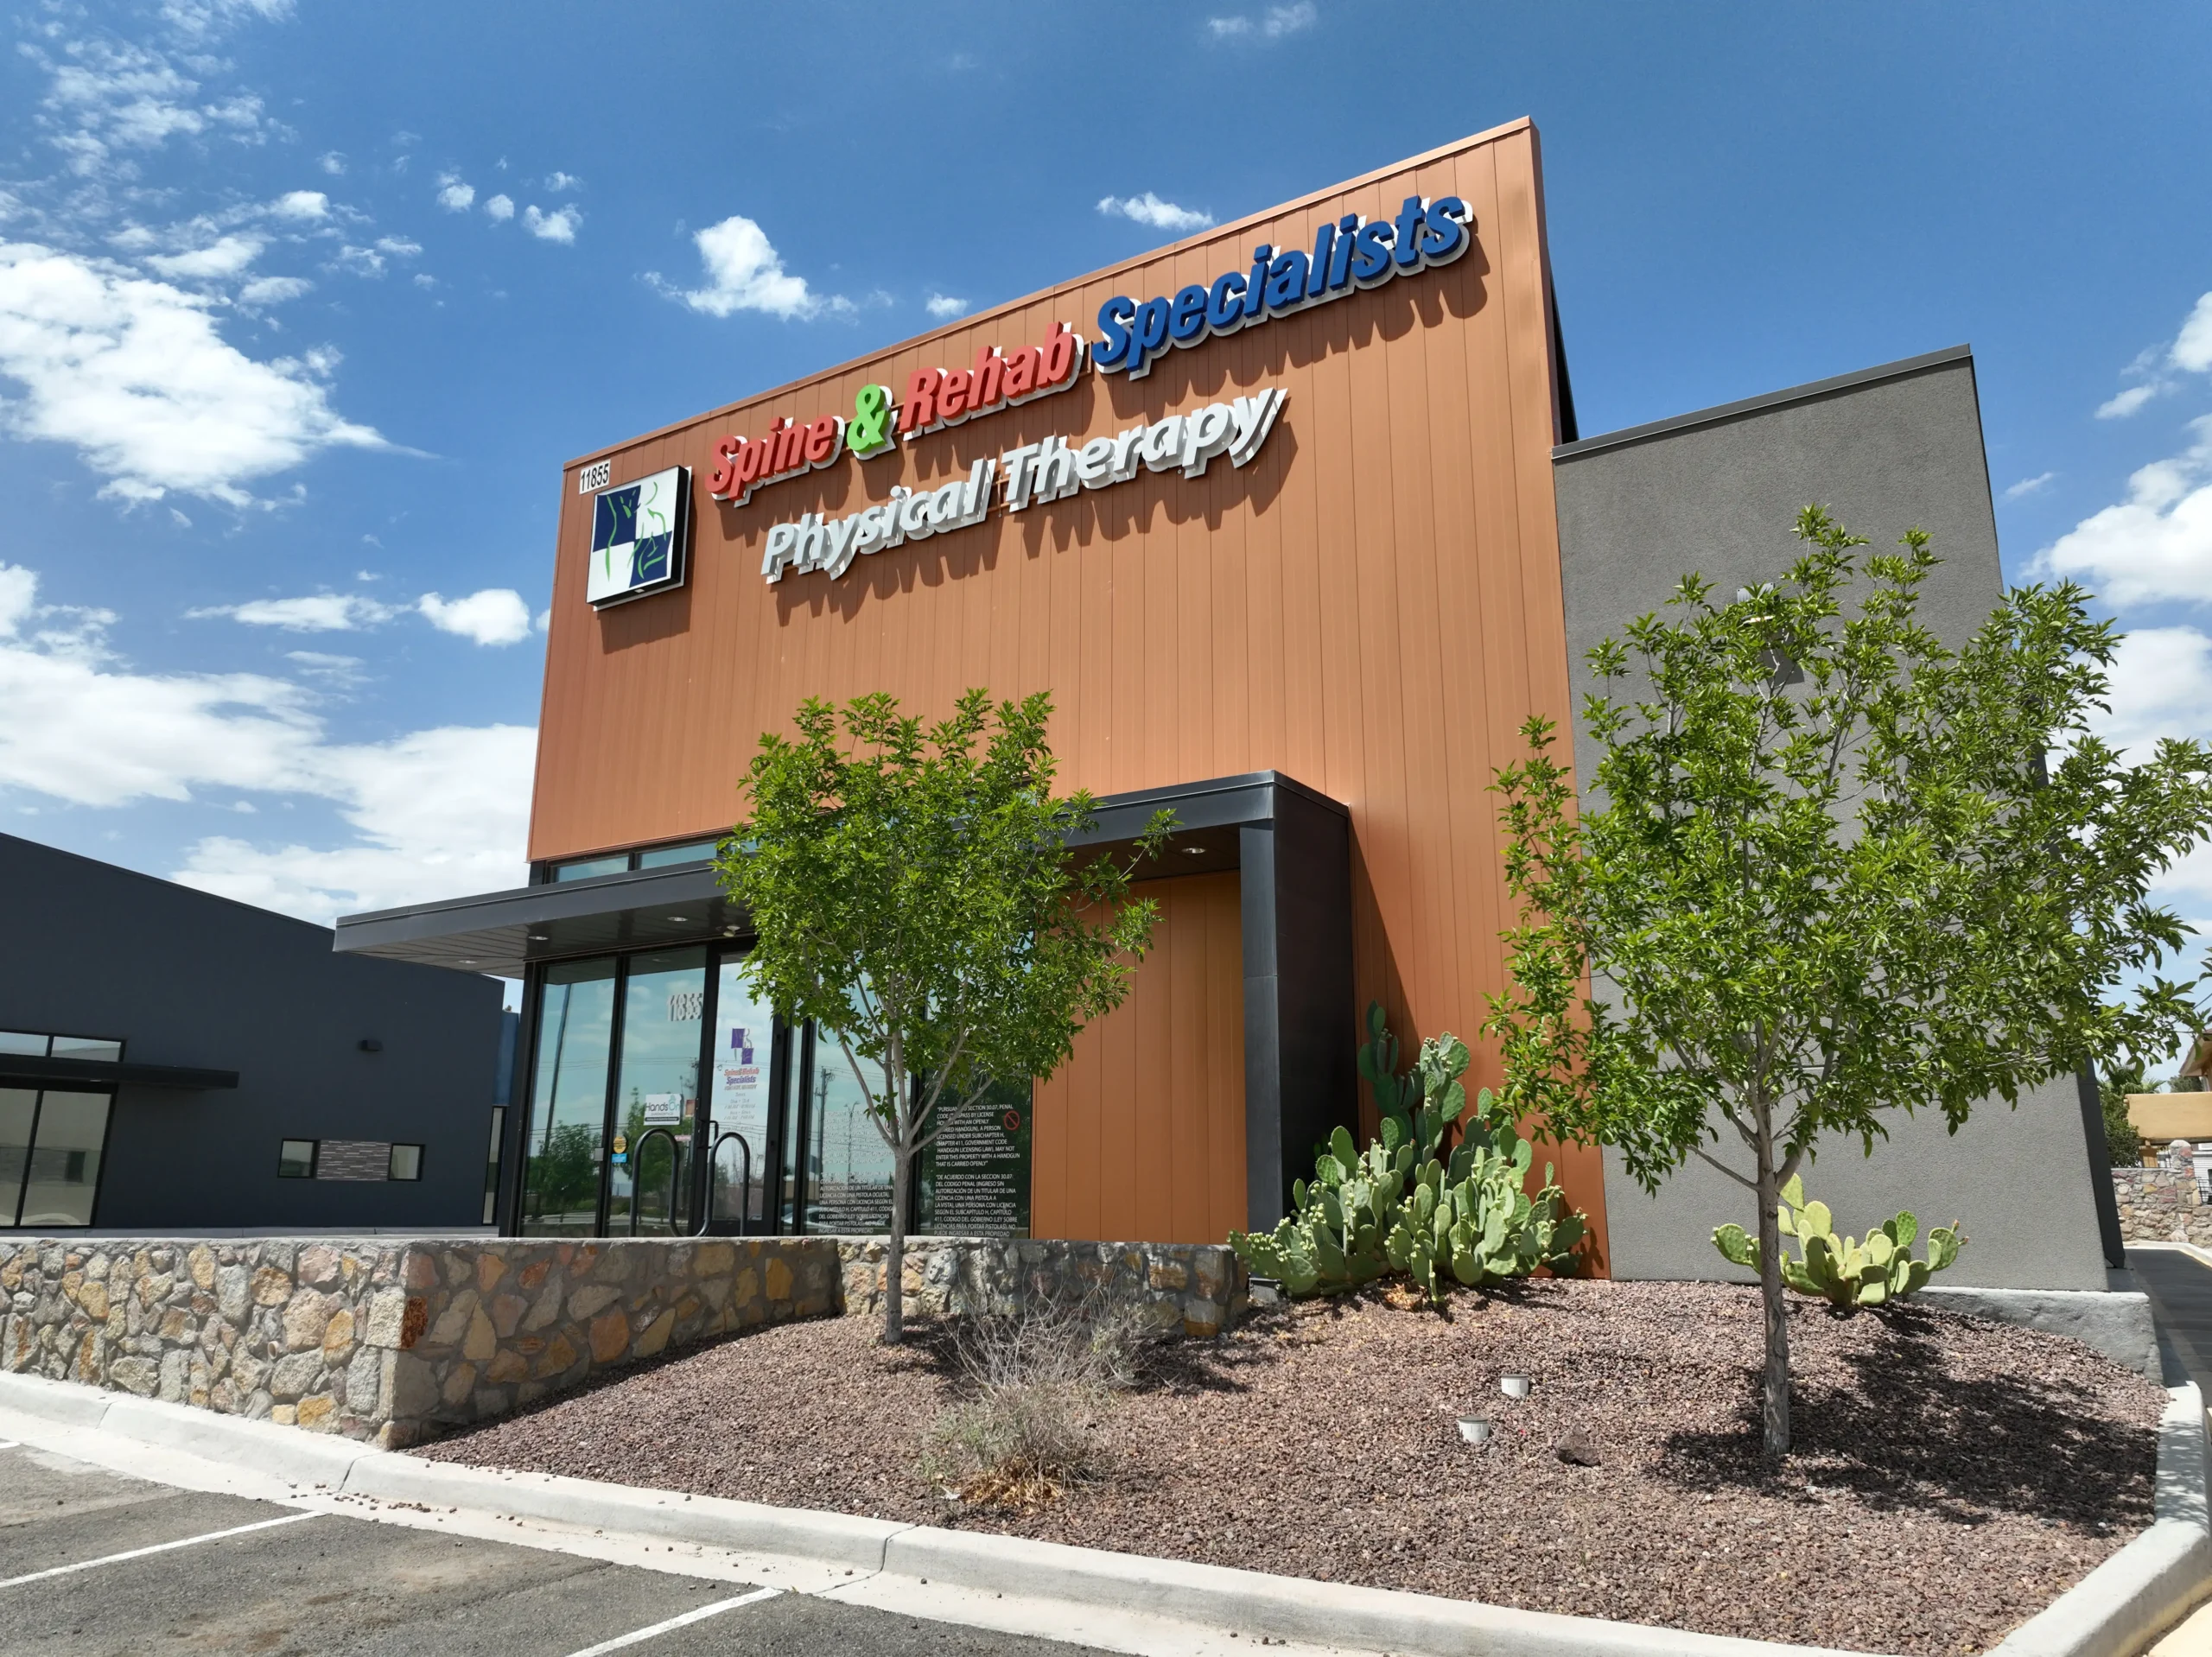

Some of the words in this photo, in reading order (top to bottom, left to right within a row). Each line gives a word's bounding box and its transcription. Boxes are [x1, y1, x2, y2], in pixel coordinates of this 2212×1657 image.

[705, 416, 842, 504] Spine
[847, 384, 893, 455] &
[899, 321, 1080, 435] Rehab
[1092, 196, 1469, 375] Specialists
[581, 463, 609, 492] 11855
[761, 459, 993, 581] Physical
[1002, 387, 1284, 509] Therapy
[667, 993, 702, 1020] 11855
[727, 1076, 757, 1085] Specialists
